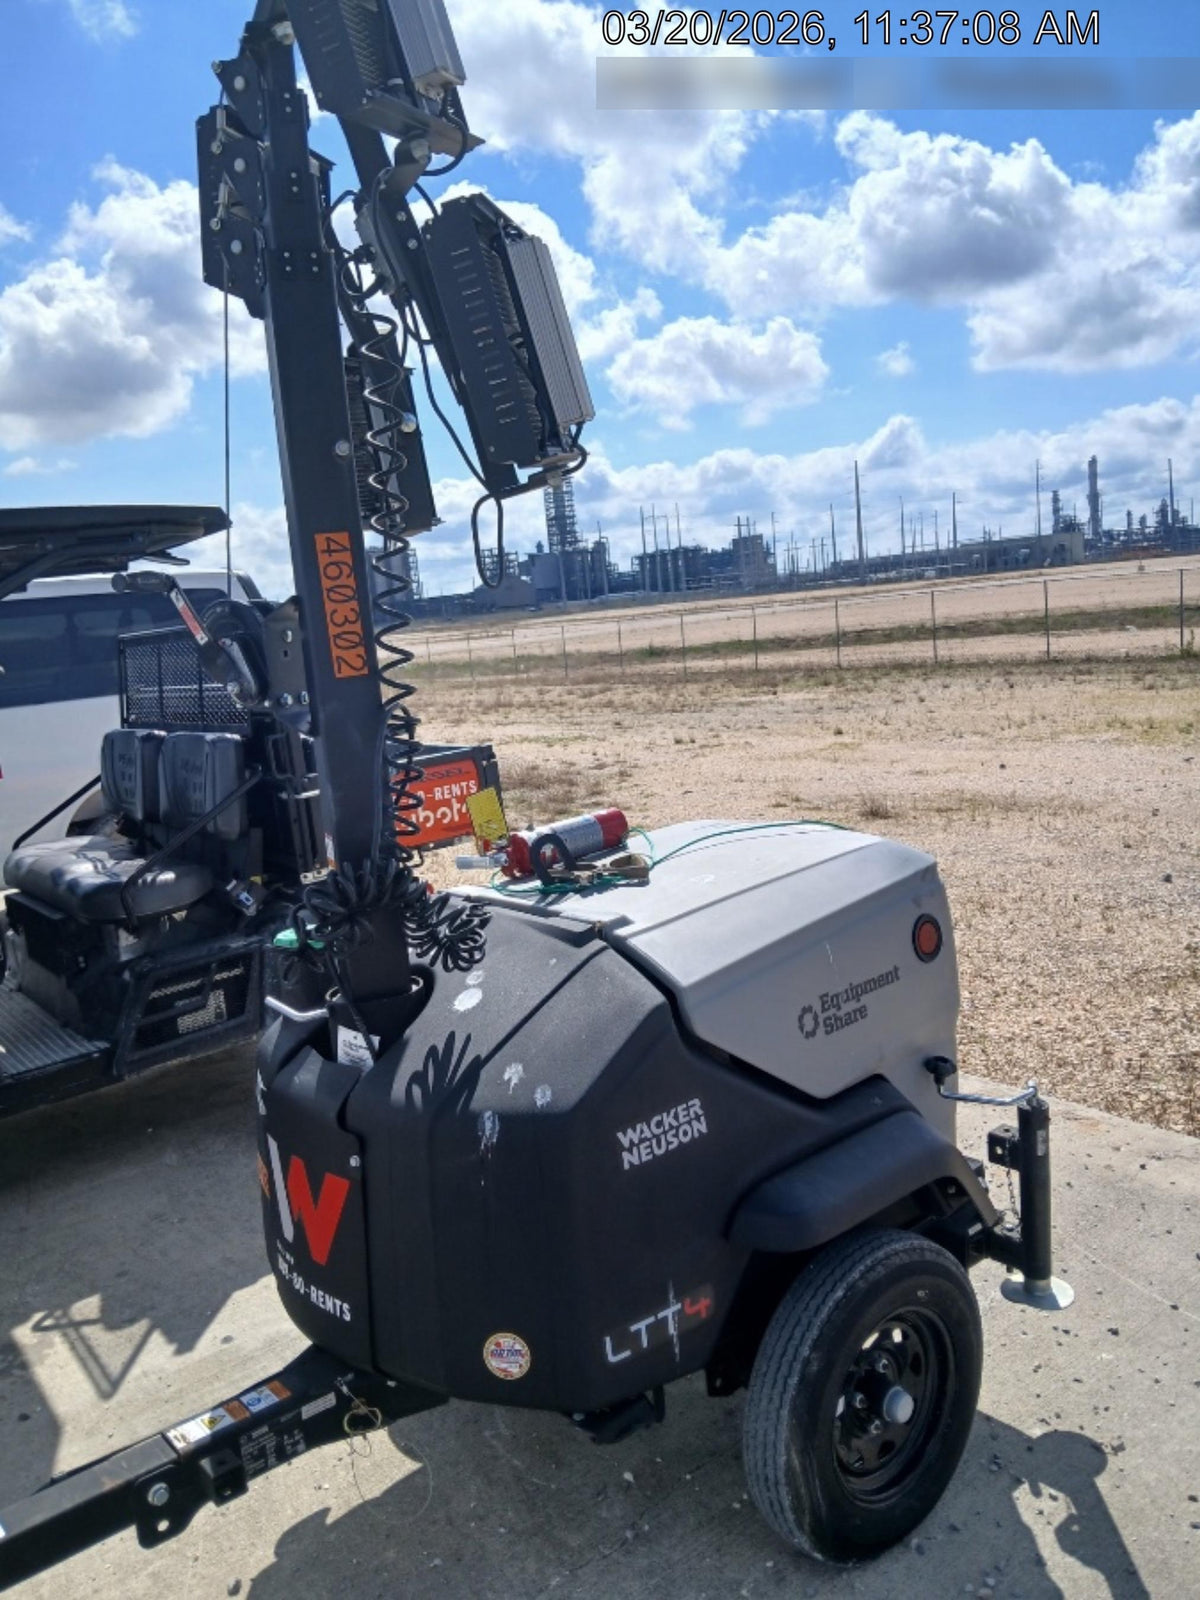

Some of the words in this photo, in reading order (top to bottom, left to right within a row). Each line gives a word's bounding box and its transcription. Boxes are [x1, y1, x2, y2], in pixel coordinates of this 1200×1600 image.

[320, 536, 367, 675] 460302
[819, 964, 900, 1014] Equipment
[823, 1004, 868, 1035] Share
[616, 1098, 704, 1149] WACKER
[622, 1115, 708, 1170] NEUSON
[604, 1297, 712, 1362] LTT4
